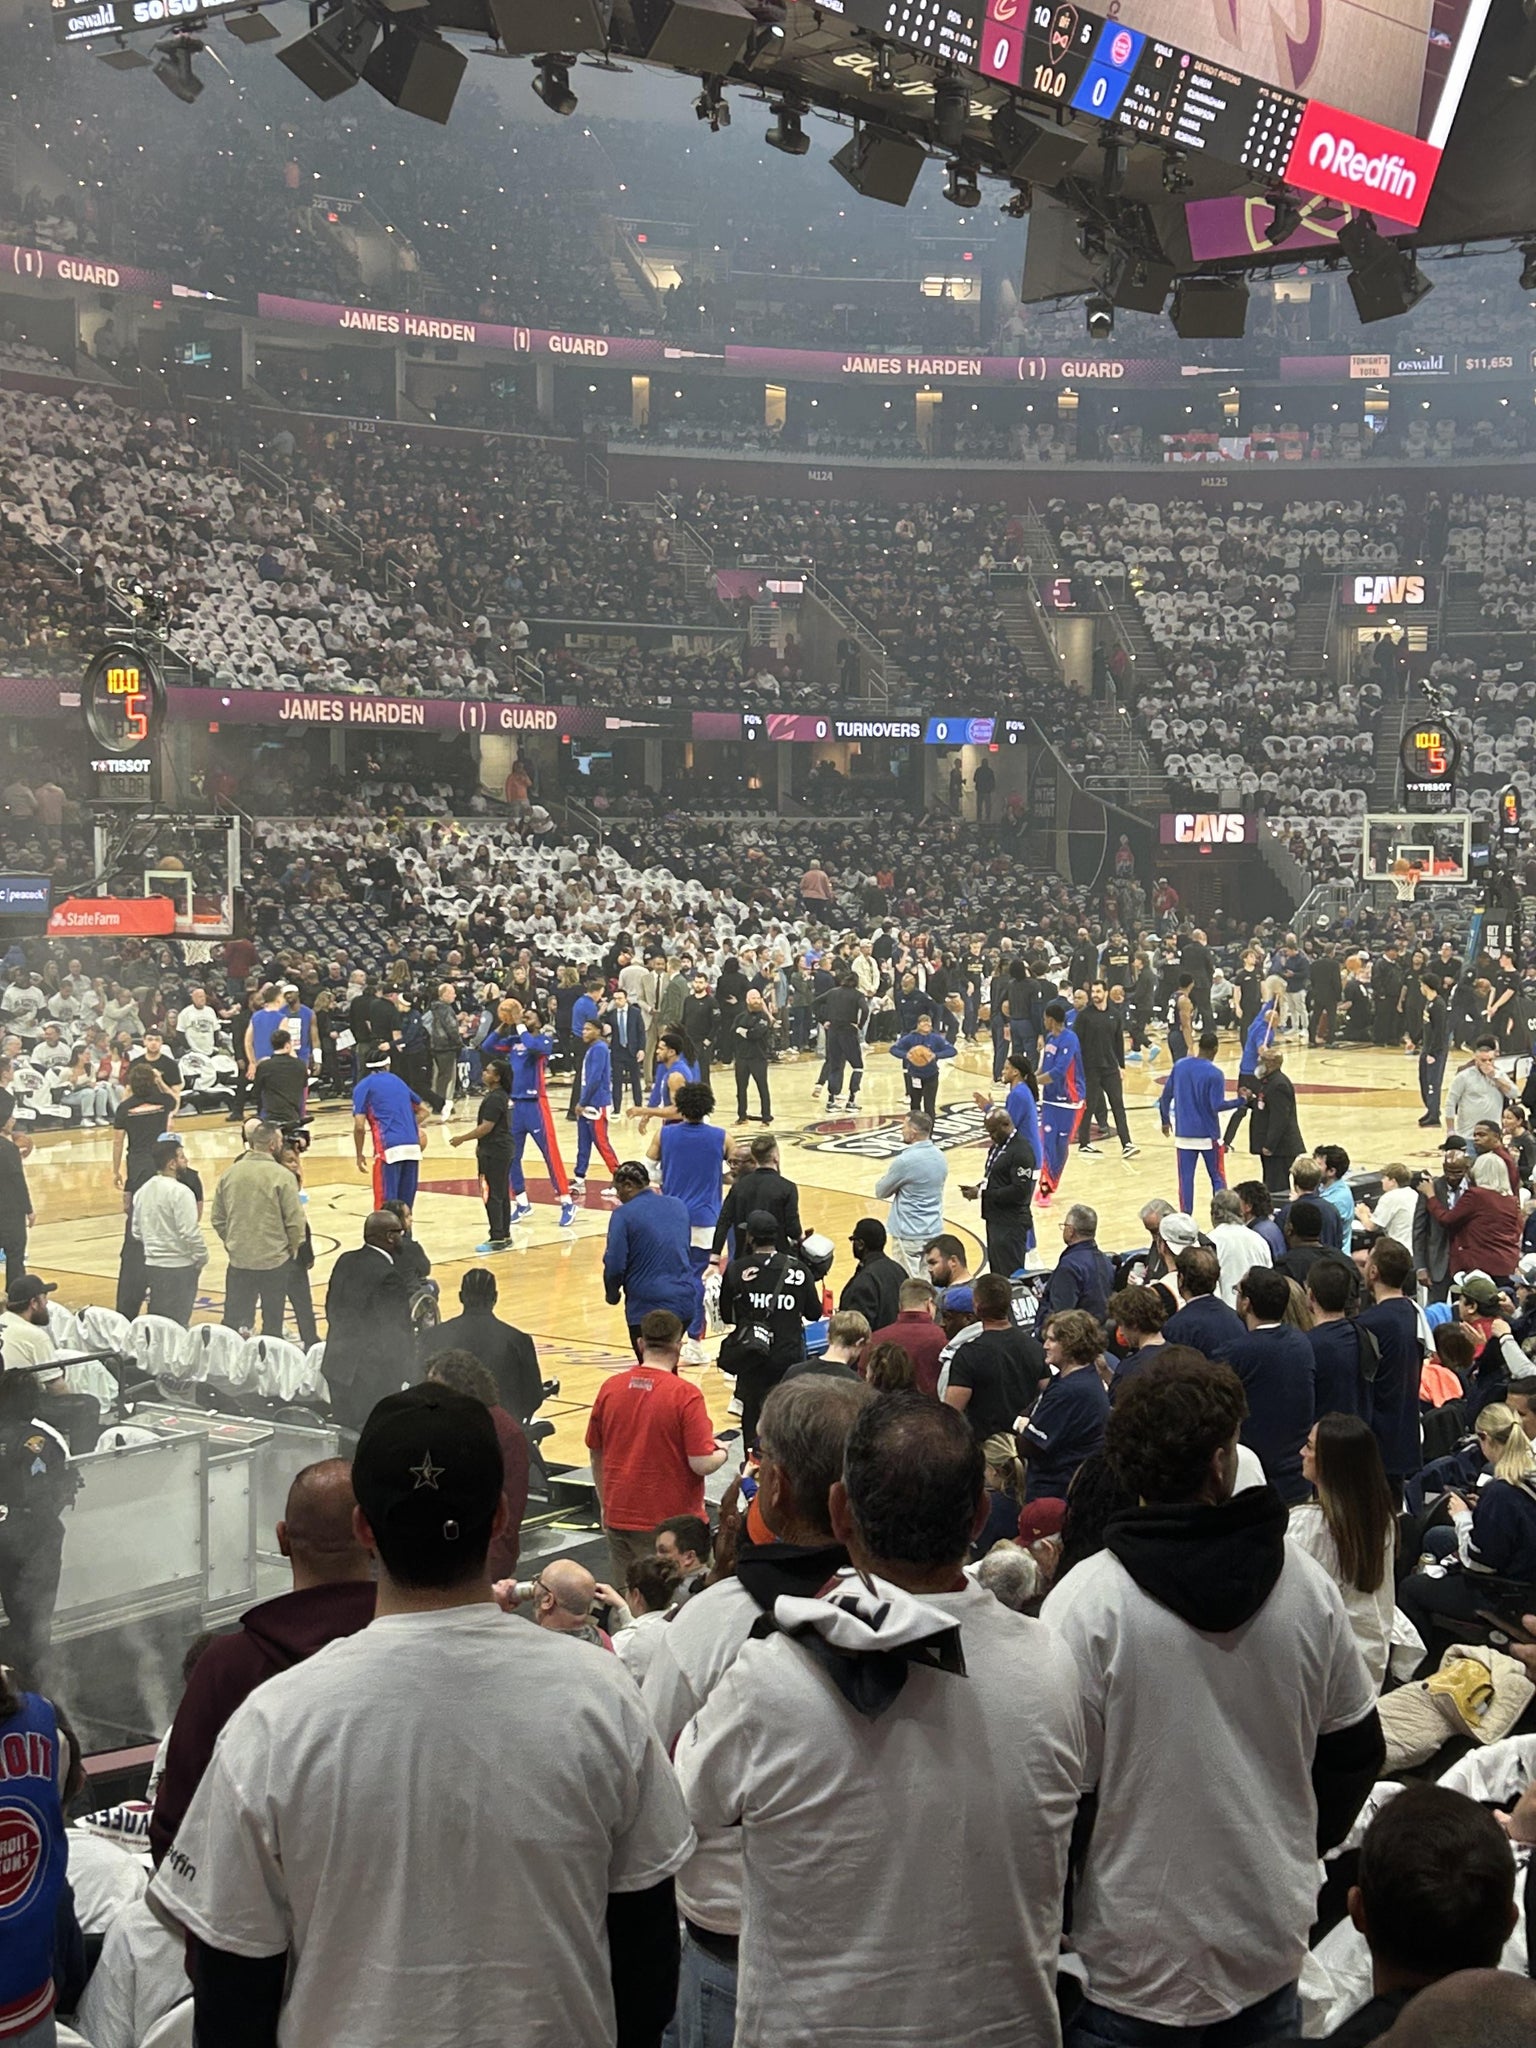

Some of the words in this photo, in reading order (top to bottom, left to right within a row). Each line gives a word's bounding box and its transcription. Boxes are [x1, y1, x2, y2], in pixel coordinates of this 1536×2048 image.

[67, 3, 116, 32] oswald
[1034, 6, 1051, 28] 1Q
[1080, 24, 1093, 44] 5
[993, 38, 1010, 69] 0
[1034, 64, 1067, 97] 10.0
[1091, 77, 1108, 107] 0
[1330, 137, 1417, 200] Redfin
[14, 246, 43, 278] (1)
[57, 259, 120, 288] GUARD
[339, 310, 400, 334] JAMES
[404, 317, 476, 343] HARDEN
[513, 326, 531, 352] (1)
[548, 335, 609, 358] GUARD
[841, 356, 902, 375] JAMES
[906, 358, 982, 377] HARDEN
[1017, 356, 1047, 381] (1)
[1061, 361, 1125, 379] GUARD
[1359, 367, 1381, 377] TOTAL
[1397, 355, 1444, 371] oswald
[1465, 356, 1514, 370] $11,653
[808, 470, 834, 482] M124
[1201, 476, 1229, 487] M125
[1353, 575, 1426, 604] CAVS
[125, 693, 148, 741] 5
[279, 698, 344, 721] JAMES
[349, 701, 425, 725] HARDEN
[459, 700, 487, 732] (1)
[500, 708, 558, 730] GUARD
[743, 714, 763, 726] FG%
[816, 720, 827, 740] 0
[835, 720, 921, 739] TURNOVERS
[936, 721, 948, 740] 0
[1005, 720, 1026, 731] FG%
[747, 729, 756, 742] 0
[1008, 732, 1018, 745] 0
[108, 759, 152, 773] TISSOT
[1429, 747, 1447, 774] 5
[1418, 782, 1452, 792] TISSOT
[1174, 813, 1246, 843] CAVS
[9, 888, 44, 903] peacock
[784, 1268, 806, 1286] 29
